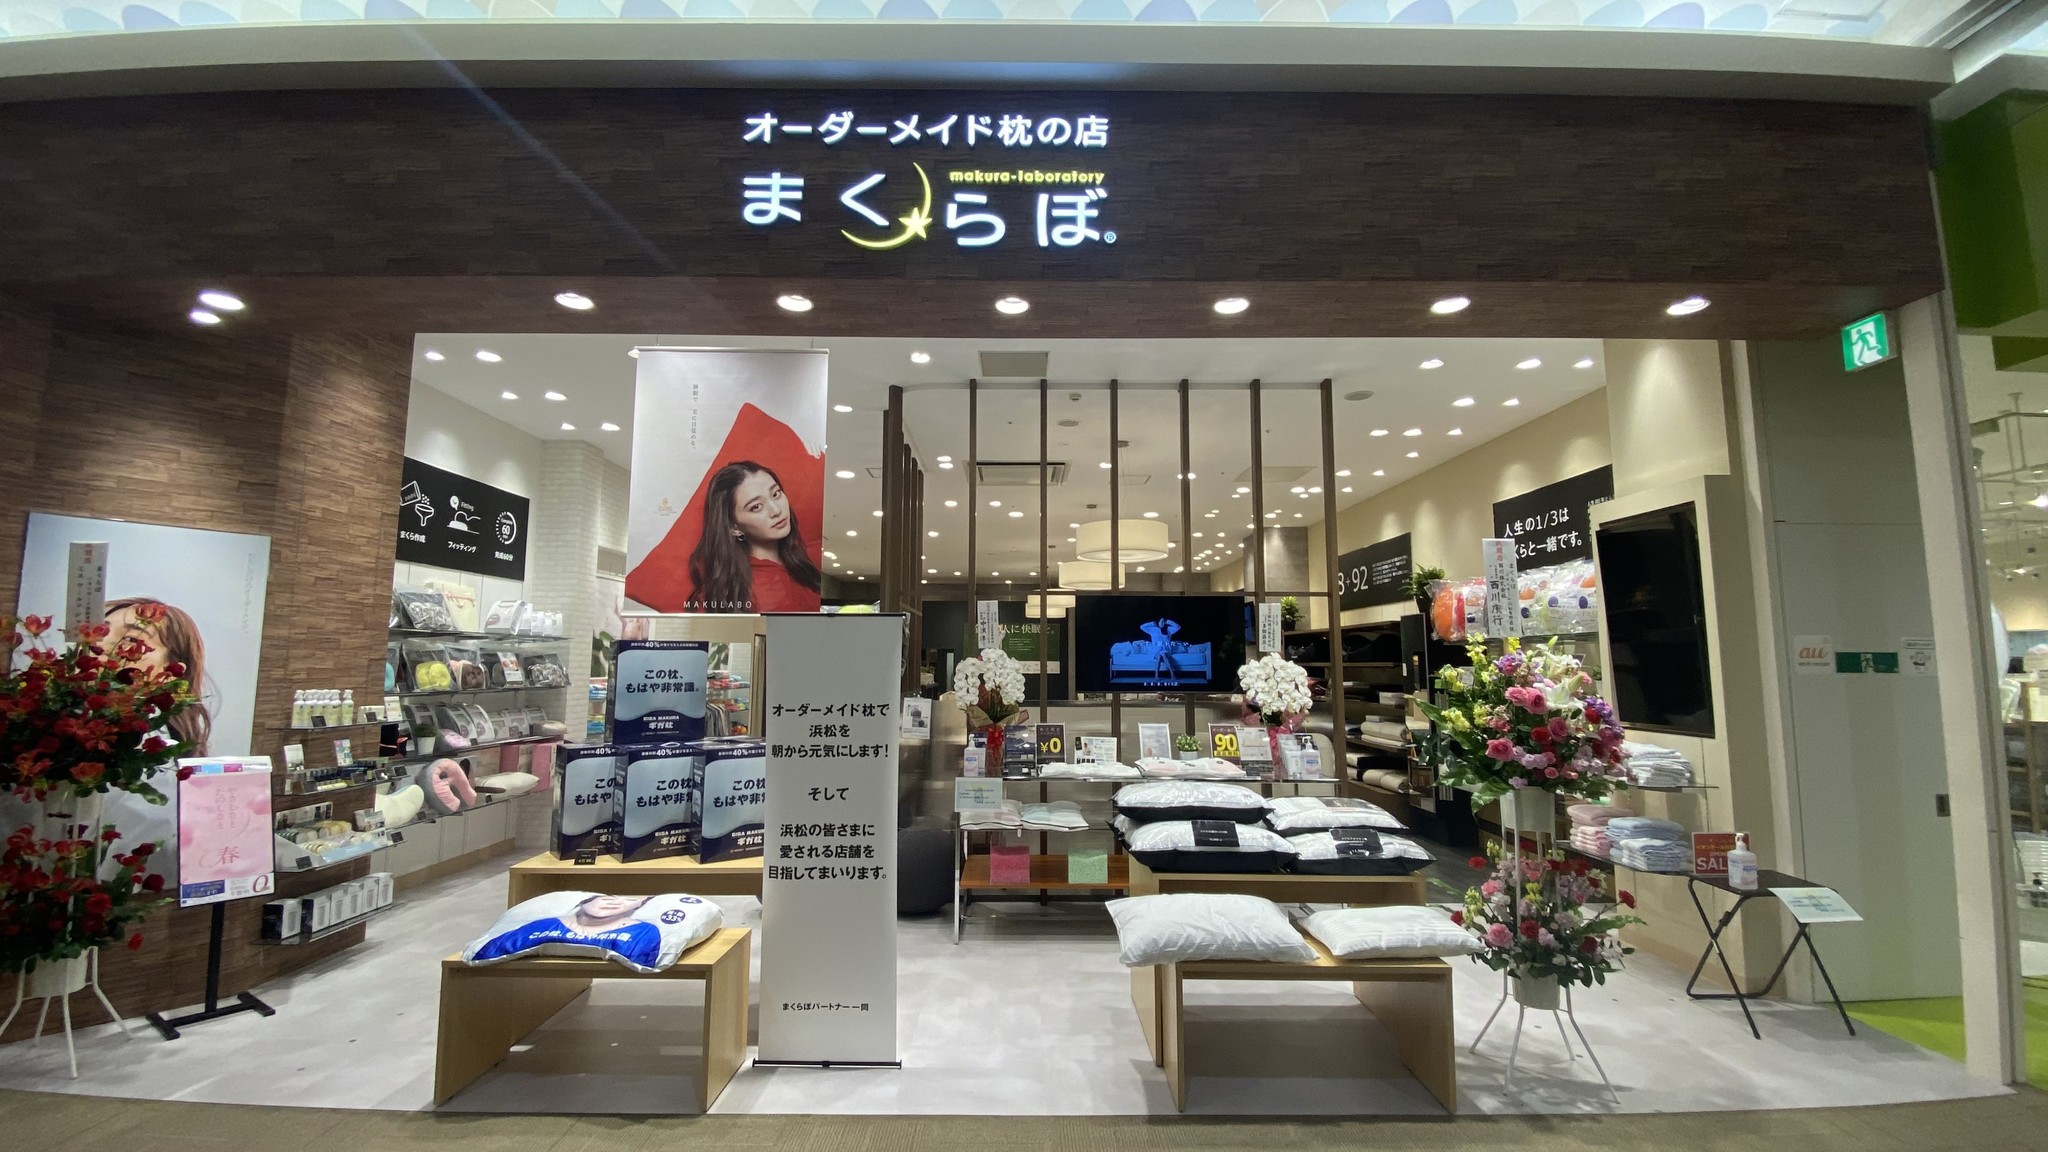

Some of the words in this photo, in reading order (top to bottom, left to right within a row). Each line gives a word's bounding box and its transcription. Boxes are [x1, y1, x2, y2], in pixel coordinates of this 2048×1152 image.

[743, 112, 1110, 148] オーダーメイド枕の店
[949, 169, 1106, 185] makura-laboratory
[1503, 507, 1570, 538] 人生の1/3は
[683, 600, 752, 609] MAKULABO
[644, 669, 683, 680] この枕、
[626, 682, 700, 694] もはや非常識。
[772, 703, 890, 717] オーダーメイド枕で
[809, 724, 850, 738] 浜松を
[1040, 737, 1061, 753] ¥0
[1214, 733, 1238, 751] 90
[771, 744, 889, 758] 朝から元気にします!
[808, 787, 849, 801] そして
[780, 823, 875, 838] 浜松の皆さまに
[780, 844, 875, 859] 愛される店舗を
[768, 865, 887, 880] 目指してまいります。
